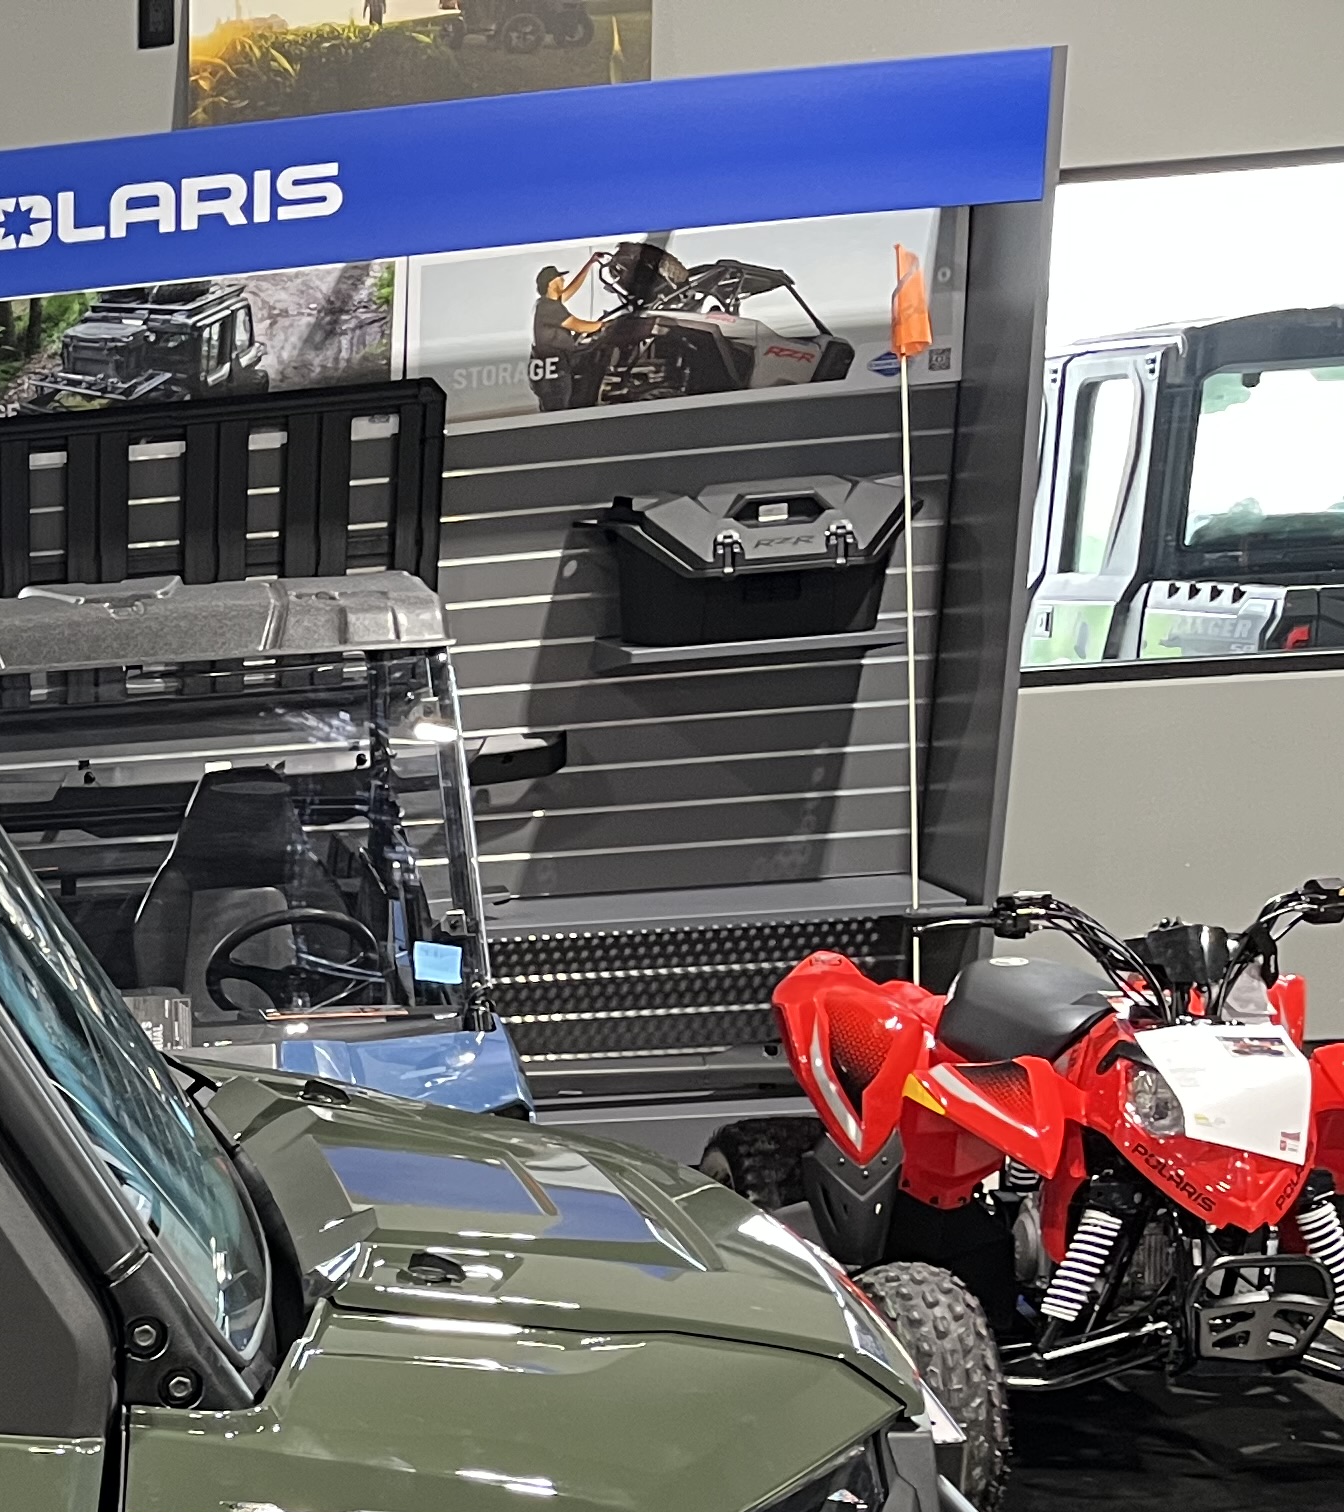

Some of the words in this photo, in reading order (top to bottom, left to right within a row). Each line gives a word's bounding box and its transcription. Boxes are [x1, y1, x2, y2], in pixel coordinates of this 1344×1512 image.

[763, 345, 817, 364] RZR
[452, 355, 560, 390] STORAGE
[753, 535, 815, 549] RZR
[1131, 1142, 1217, 1213] POLARIS
[1275, 1166, 1305, 1211] POLA
